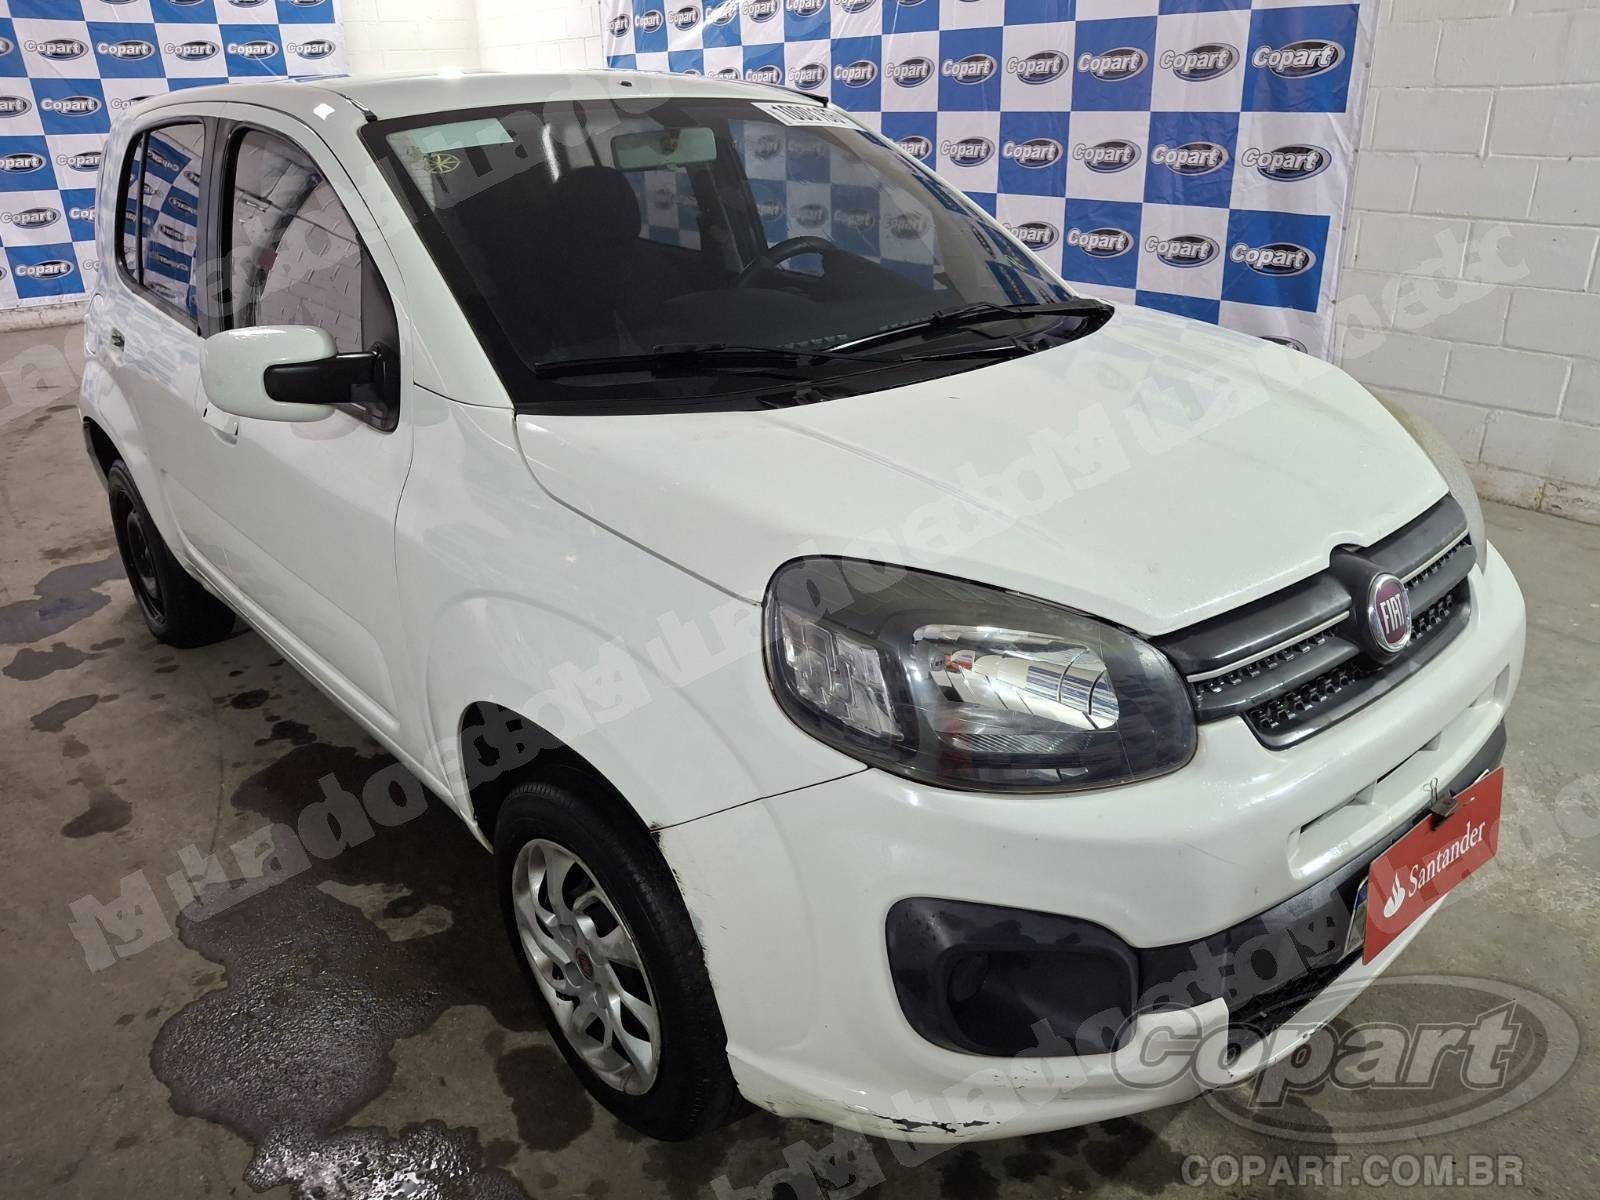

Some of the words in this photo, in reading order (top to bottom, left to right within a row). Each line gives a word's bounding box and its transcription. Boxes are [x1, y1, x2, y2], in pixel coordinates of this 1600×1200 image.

[668, 10, 697, 27] Copart
[24, 40, 81, 55] Copart
[97, 42, 149, 57] Copart
[164, 43, 212, 57] Copart
[227, 42, 273, 56] Copart
[287, 42, 330, 56] Copart
[942, 58, 990, 78] Copart
[1006, 54, 1061, 79] Copart
[1077, 50, 1141, 76] Copart
[1158, 49, 1227, 75] Copart
[1252, 45, 1336, 72] Copart
[788, 64, 823, 82] Copart
[833, 64, 873, 82] Copart
[885, 60, 928, 80] Copart
[40, 98, 95, 114] Copart
[940, 139, 987, 160] Copart
[1002, 140, 1056, 161] Copart
[1072, 143, 1133, 165] Copart
[1151, 143, 1219, 167] Copart
[56, 153, 101, 169] Copar
[1241, 148, 1318, 173] Copart
[0, 209, 54, 226] Copart
[1066, 228, 1128, 251] Copart
[1144, 235, 1211, 259] Copart
[1230, 242, 1306, 270] Copart
[14, 262, 68, 278] Copart
[1379, 593, 1405, 634] FIAT
[1408, 820, 1486, 898] Santander
